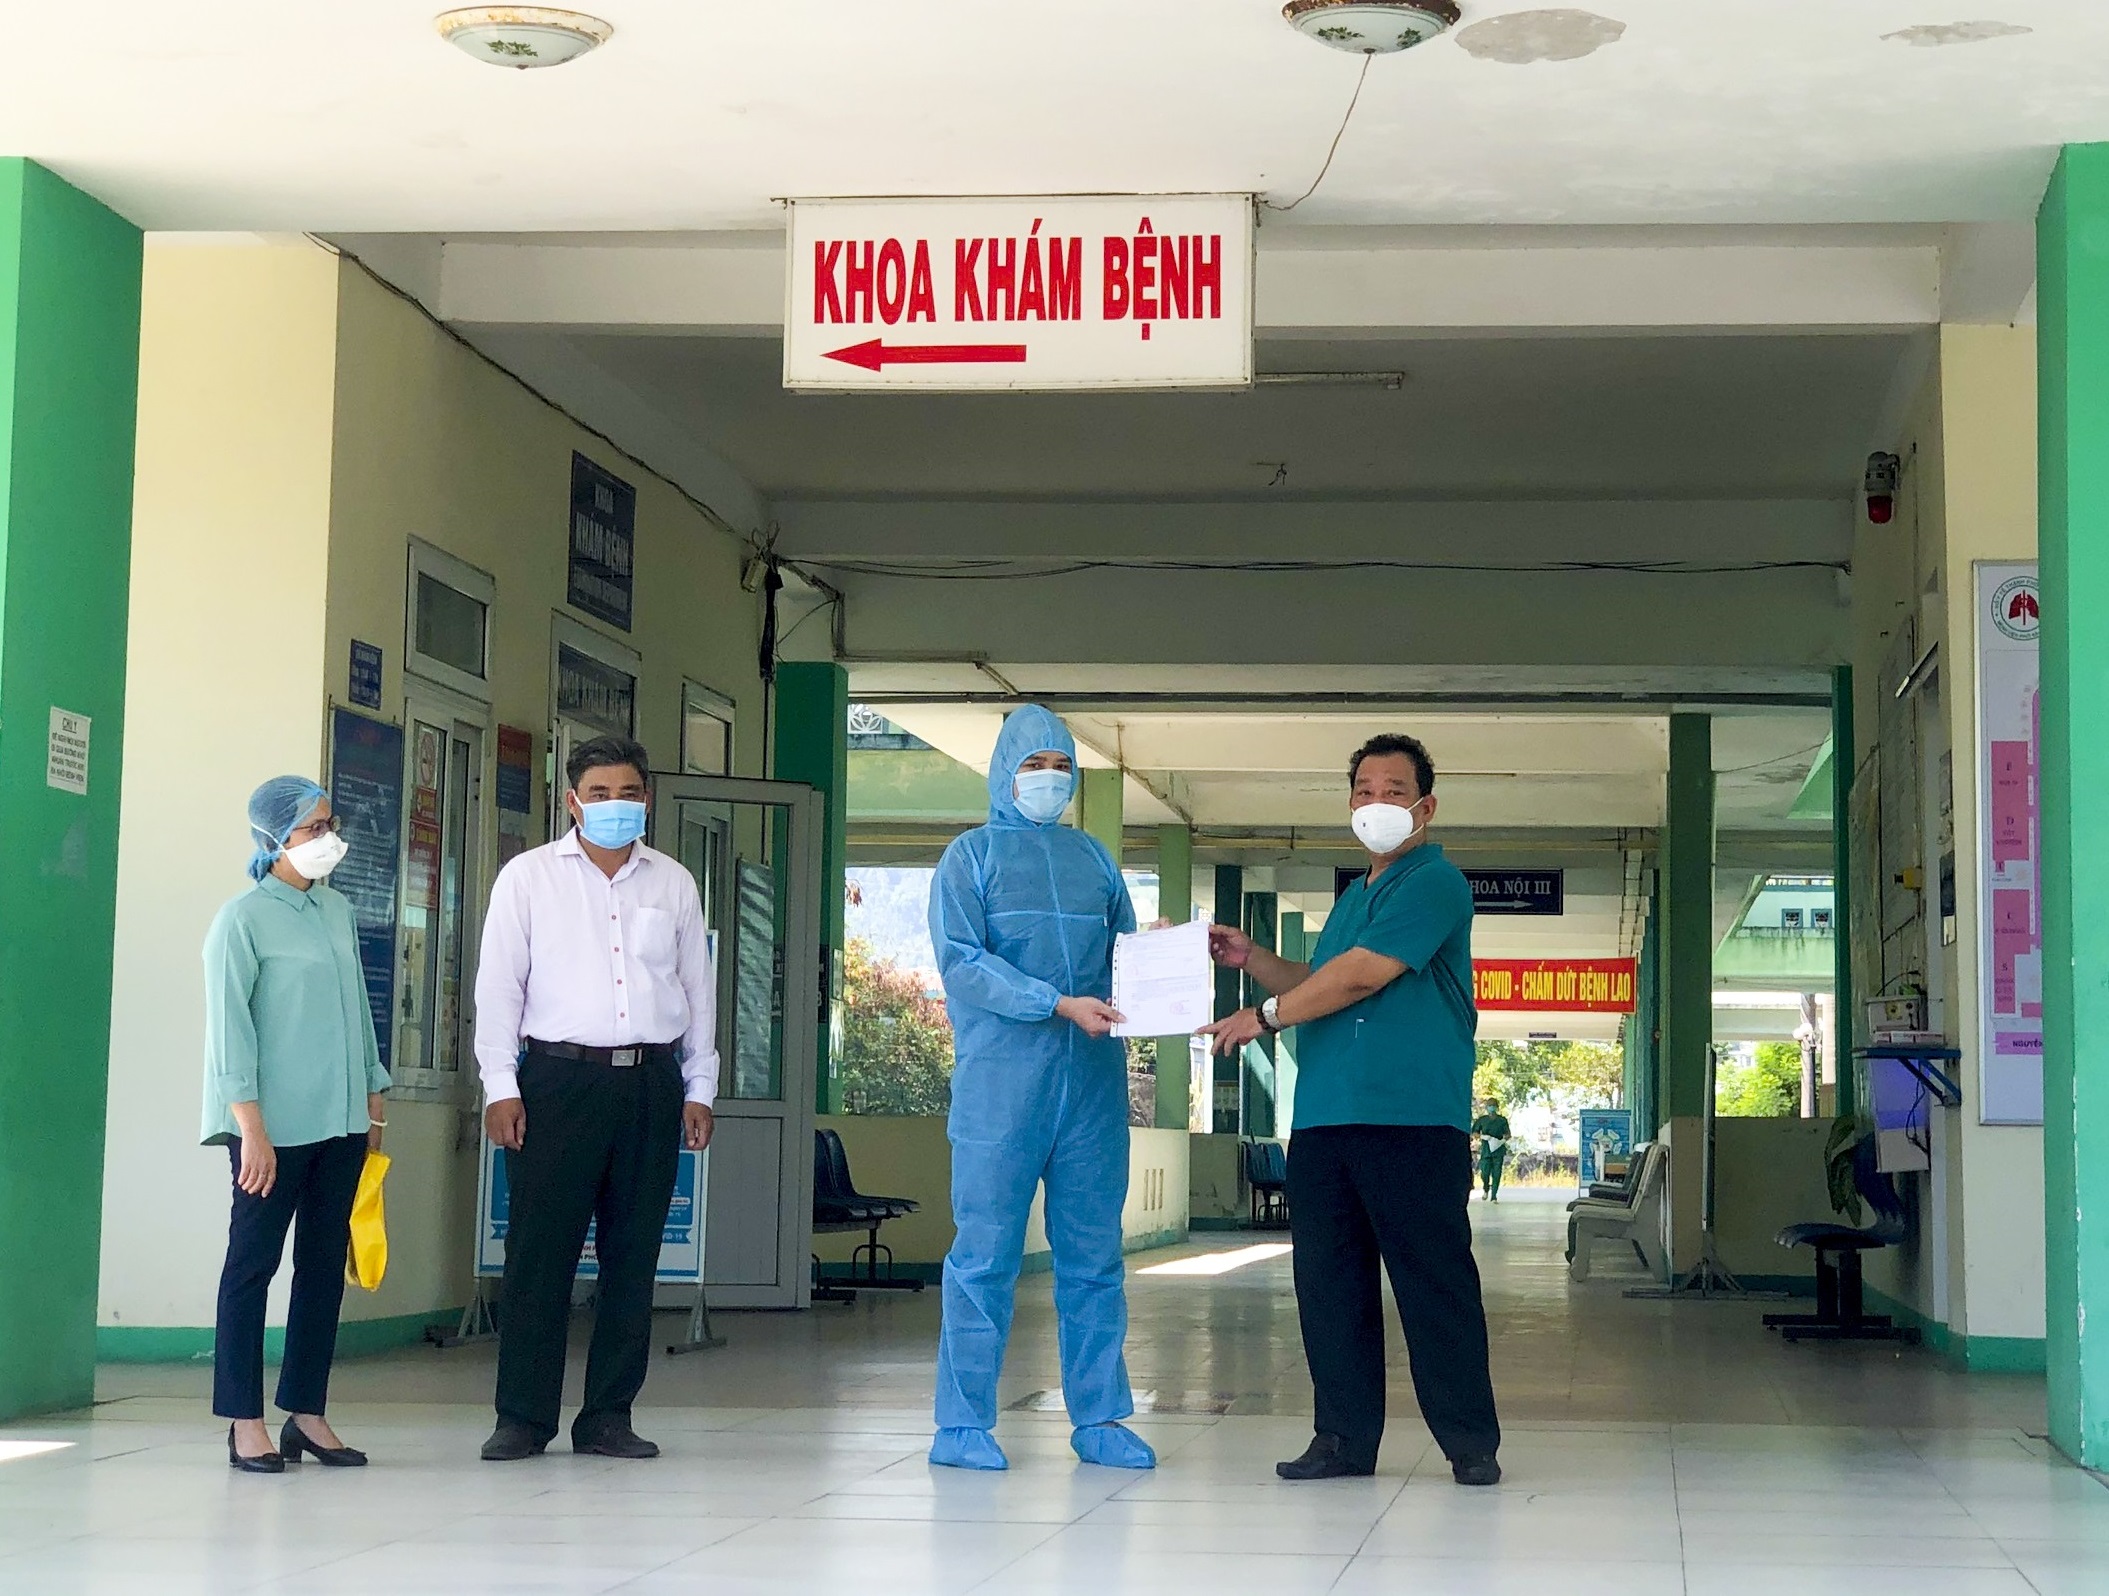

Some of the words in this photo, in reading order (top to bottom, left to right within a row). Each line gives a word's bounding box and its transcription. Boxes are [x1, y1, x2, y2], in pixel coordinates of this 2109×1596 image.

[814, 238, 936, 325] KHOA
[954, 218, 1082, 322] KHÁM
[1103, 217, 1221, 340] BỆNH
[1469, 880, 1500, 894] HOA
[1503, 876, 1530, 898] NỘI
[1534, 880, 1551, 895] III
[1481, 970, 1512, 1000] COVID
[1522, 960, 1554, 1001] CHẤM
[1556, 965, 1577, 1001] DỨT
[1579, 965, 1608, 1008] BỆNH
[1611, 972, 1631, 1002] LAO
